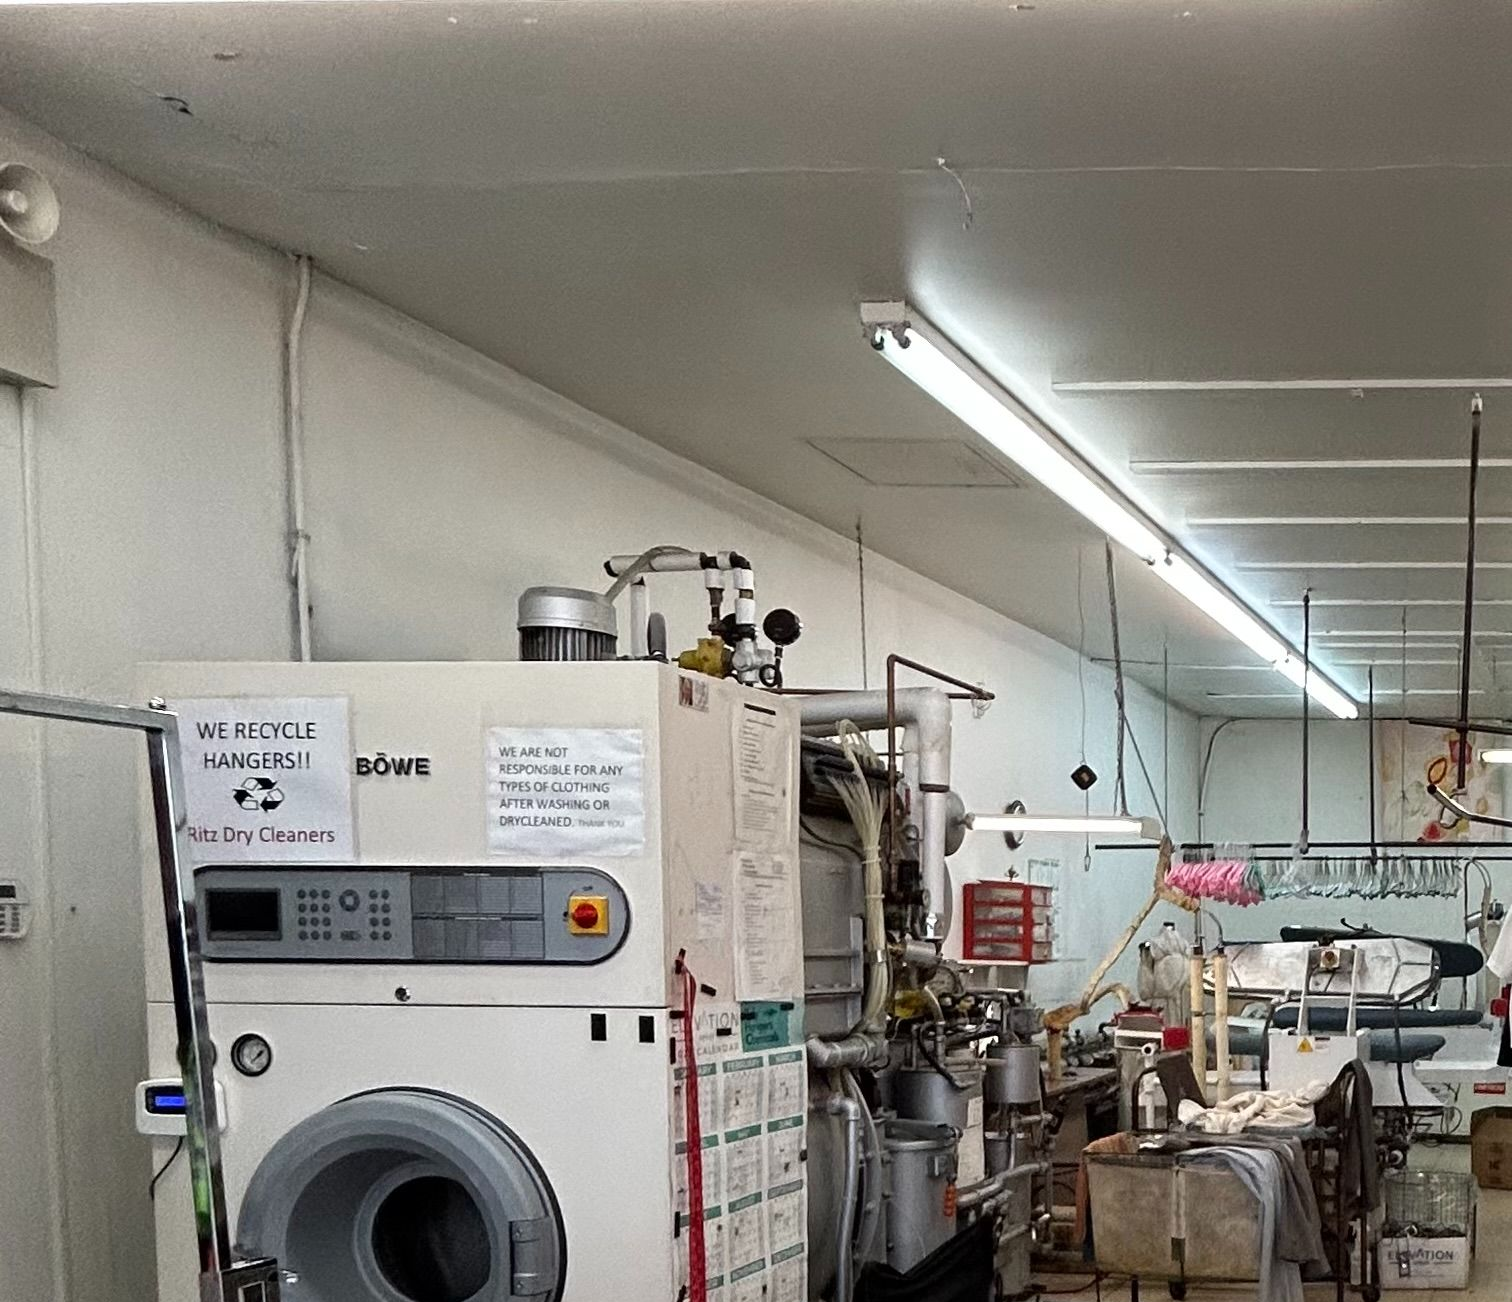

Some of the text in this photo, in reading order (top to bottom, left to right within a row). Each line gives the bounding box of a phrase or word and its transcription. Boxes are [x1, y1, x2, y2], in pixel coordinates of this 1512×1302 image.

[197, 722, 317, 740] WE RECYCLE
[499, 747, 568, 758] WE ARE NOT
[203, 752, 311, 769] HANGERS!!
[499, 764, 623, 776] RESPONSIBLE FOR ANY
[499, 781, 610, 793] TYPES OF CLOTHING
[499, 798, 610, 811] AFTER WASHING OR
[188, 826, 336, 846] Ritz Dry Cleaners
[672, 1010, 738, 1033] ELVATION
